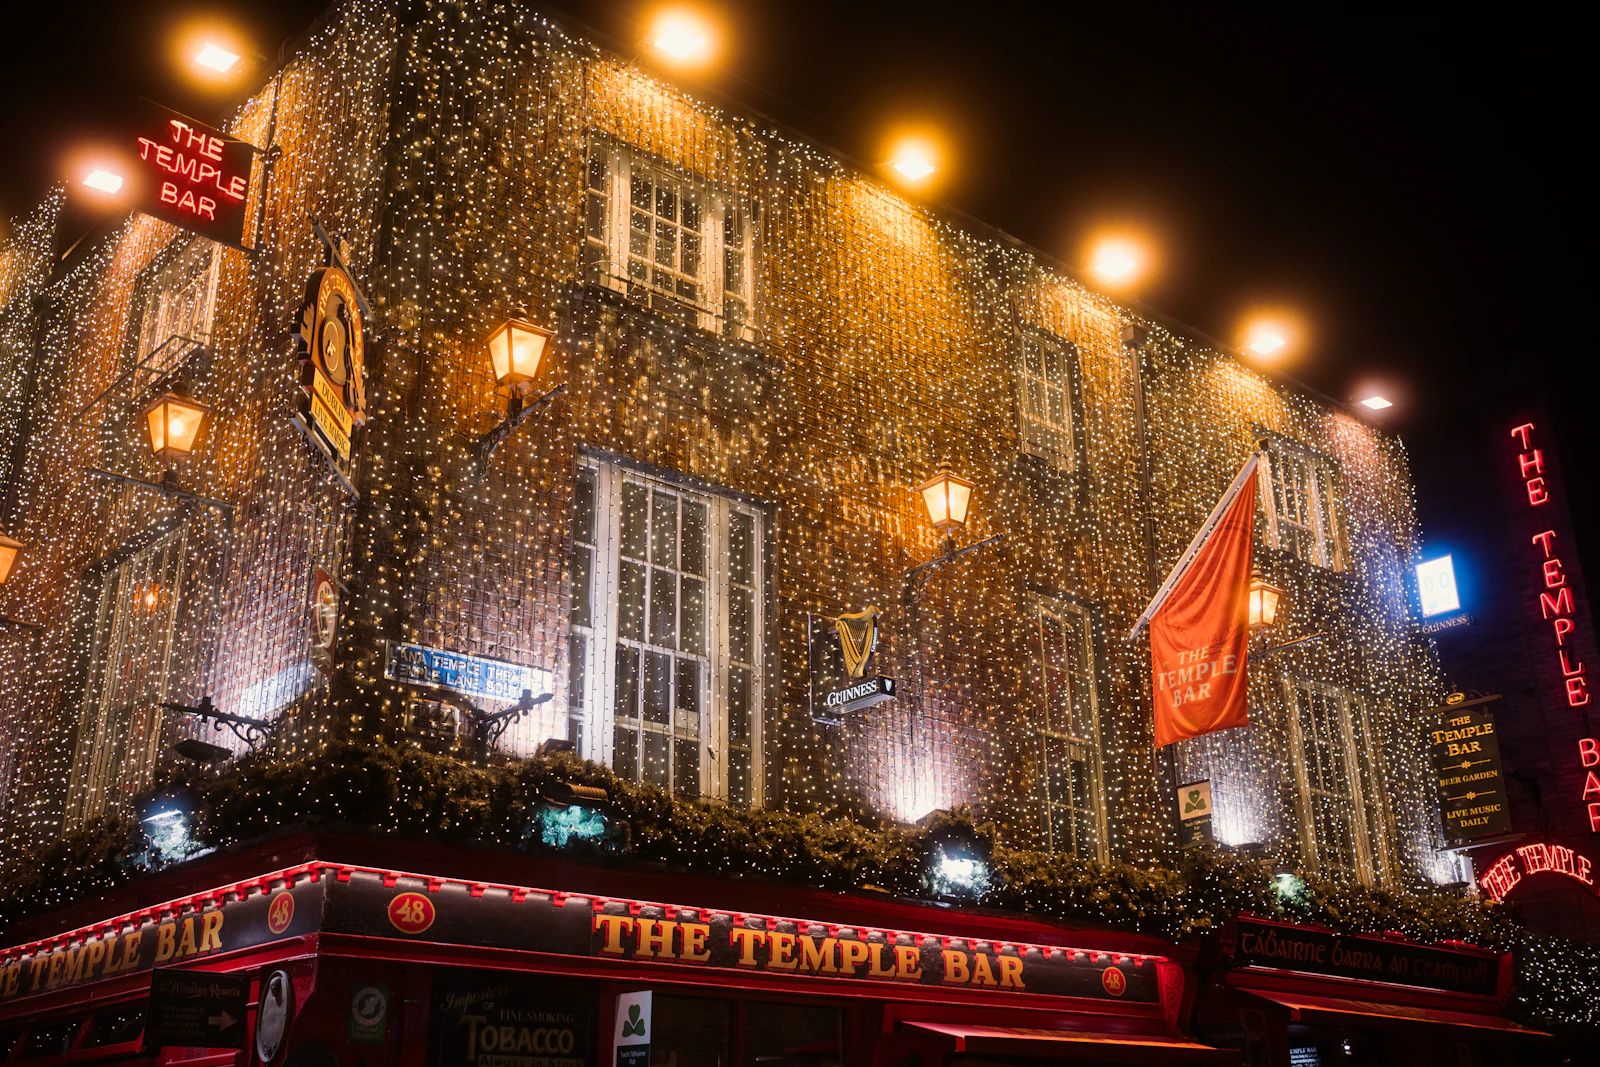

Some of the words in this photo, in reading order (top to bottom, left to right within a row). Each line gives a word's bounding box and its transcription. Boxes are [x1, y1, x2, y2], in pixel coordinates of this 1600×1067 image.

[170, 119, 225, 162] THE
[138, 137, 247, 200] TEMPLE
[161, 182, 217, 222] BAR
[318, 280, 332, 318] THE
[322, 381, 347, 424] DUBLIN
[314, 402, 329, 430] LIVE
[329, 422, 348, 453] MUSIC
[1511, 422, 1549, 506] THE
[1532, 529, 1591, 707] TEMPLE
[1422, 614, 1467, 635] GUINNESS
[432, 655, 480, 677] TEMPLE
[1177, 645, 1209, 666] THE
[390, 662, 440, 683] TEMPLE
[446, 671, 480, 690] LANE
[1157, 654, 1238, 691] TEMPLE
[827, 680, 877, 706] GUINNESS
[1172, 682, 1212, 708] BAR
[1431, 723, 1494, 745] TEMPLE
[1449, 715, 1471, 727] THE
[1447, 741, 1482, 757] BAR
[1439, 777, 1462, 787] BEER
[1462, 770, 1499, 783] GARDEN
[1446, 809, 1469, 819] LIVE
[1470, 804, 1502, 815] MUSIC
[1460, 816, 1490, 828] DAILY
[1480, 854, 1521, 902] THE
[1516, 843, 1594, 886] TEMPLE
[272, 899, 289, 927] 48
[395, 897, 425, 924] 48
[29, 931, 143, 992] TEMPLE
[154, 910, 225, 964] BAR
[593, 913, 712, 962] THE
[730, 927, 923, 981] TEMPLE
[942, 948, 1027, 990] BAR
[209, 983, 241, 999] Reserve
[1106, 971, 1121, 990] 48
[440, 983, 509, 1013] Importers
[483, 1001, 495, 1010] OF
[500, 1009, 525, 1021] FINE
[526, 1010, 575, 1024] SMOKING
[456, 1014, 575, 1063] TOBACCO
